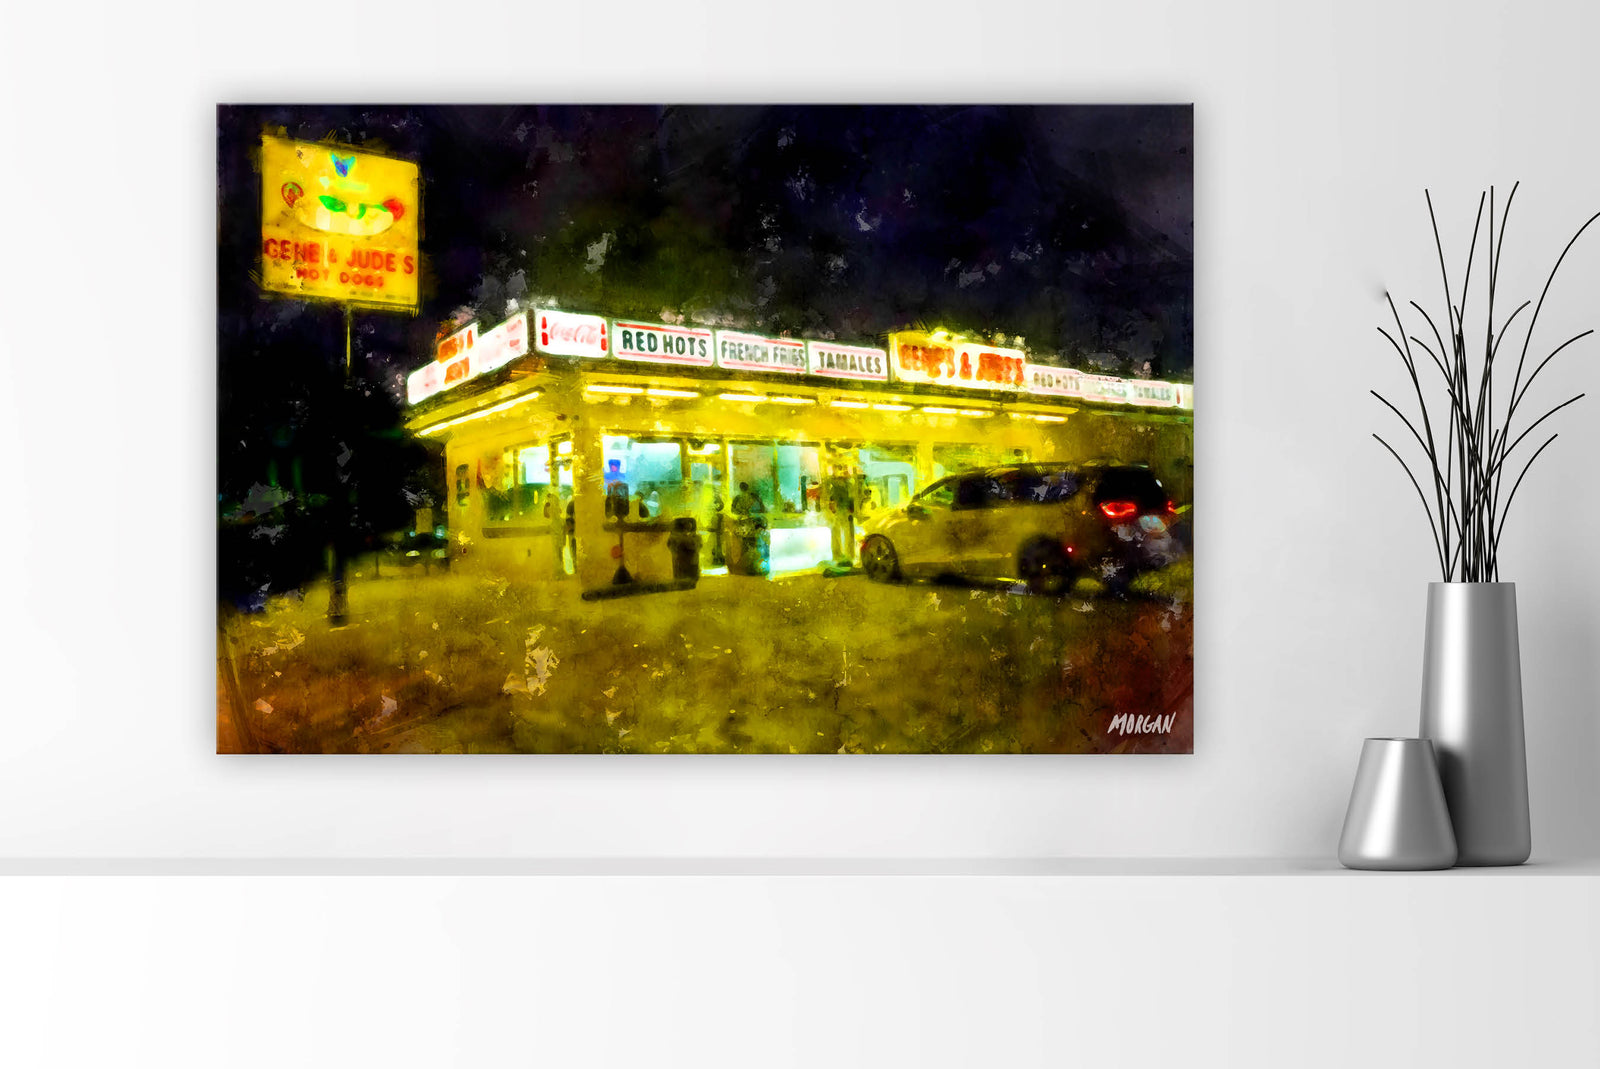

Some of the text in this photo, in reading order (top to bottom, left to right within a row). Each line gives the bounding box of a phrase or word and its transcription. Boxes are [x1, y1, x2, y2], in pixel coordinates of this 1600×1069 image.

[263, 238, 320, 263] GENE
[622, 329, 707, 357] RED HOTS
[721, 340, 805, 367] FRENCH FRIES
[818, 351, 882, 374] TAMALES
[1107, 712, 1177, 737] MORGAN
